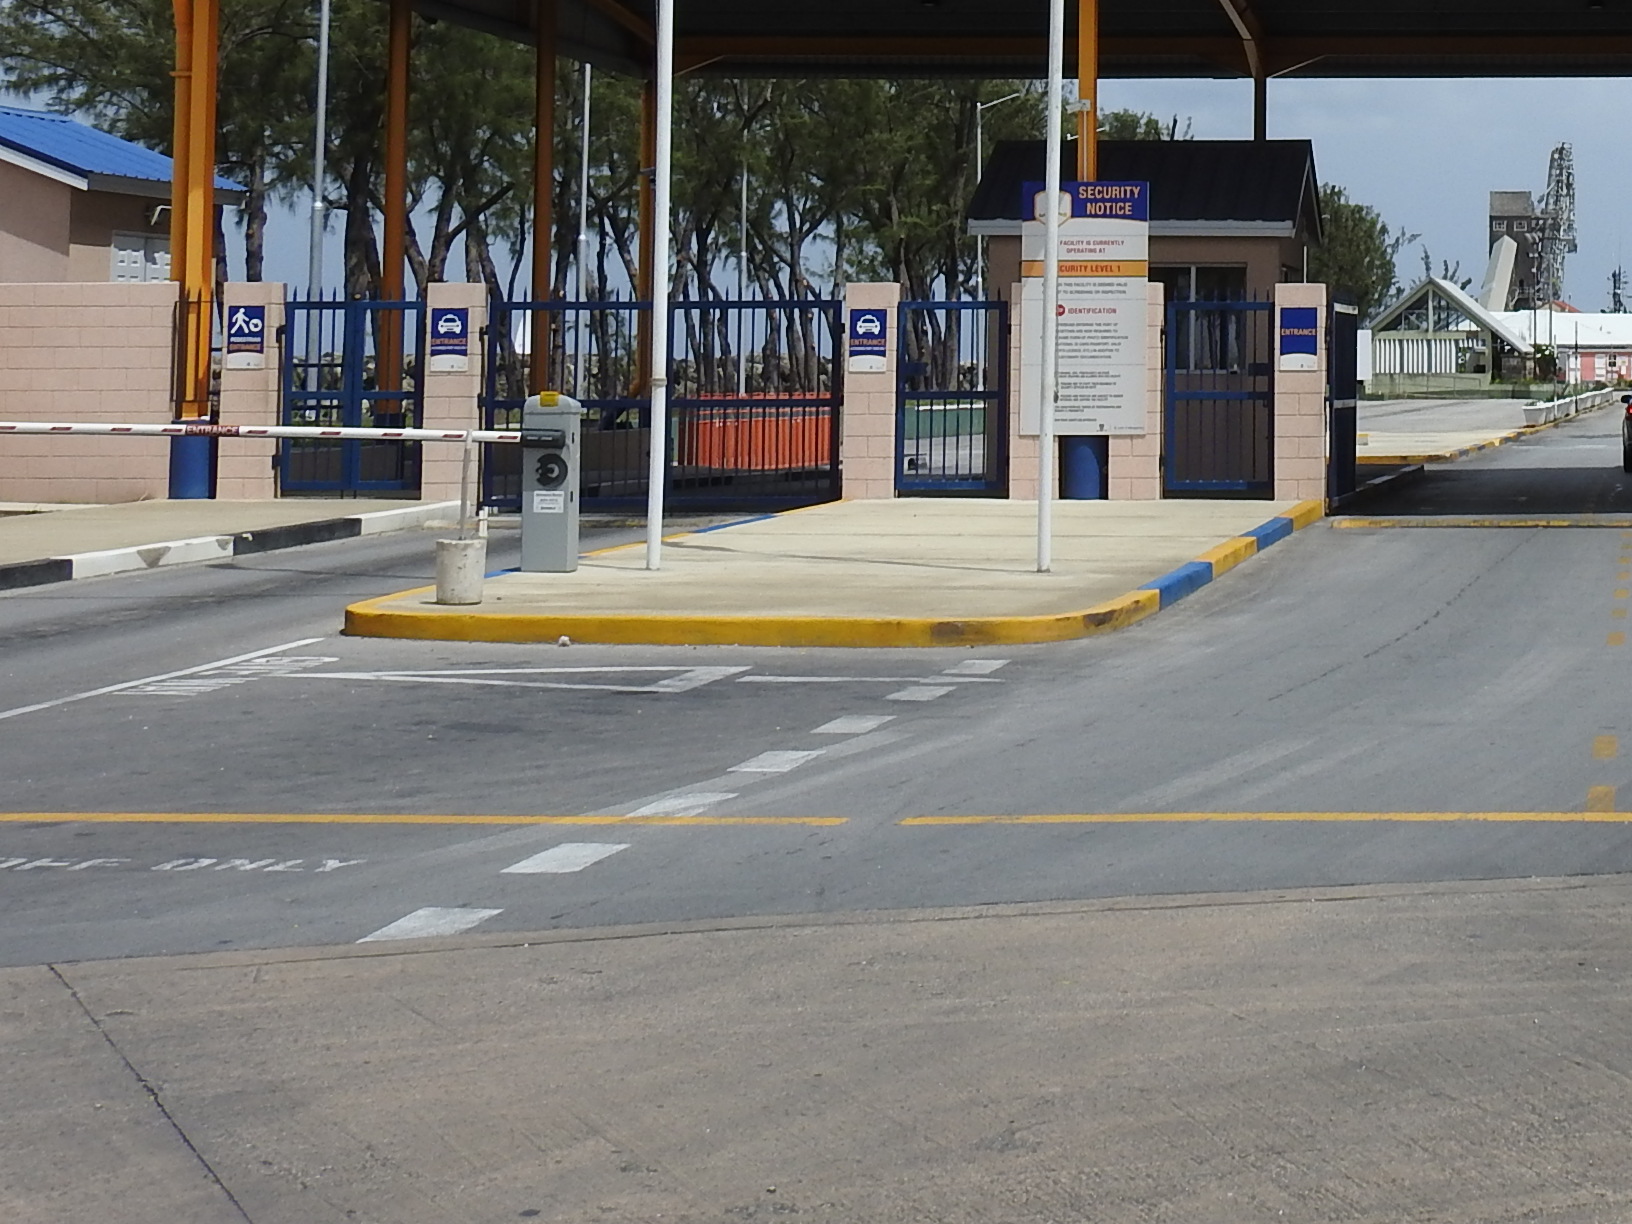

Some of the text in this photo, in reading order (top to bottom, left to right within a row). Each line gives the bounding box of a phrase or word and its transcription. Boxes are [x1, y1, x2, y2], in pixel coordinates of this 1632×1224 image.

[1078, 186, 1141, 199] SECURITY
[1086, 202, 1133, 215] NOTICE
[1059, 264, 1121, 273] CURITY LEVEL 1
[1281, 328, 1316, 336] ENTRANCE
[186, 425, 239, 435] ENTRANCE
[150, 857, 368, 874] ONLY
